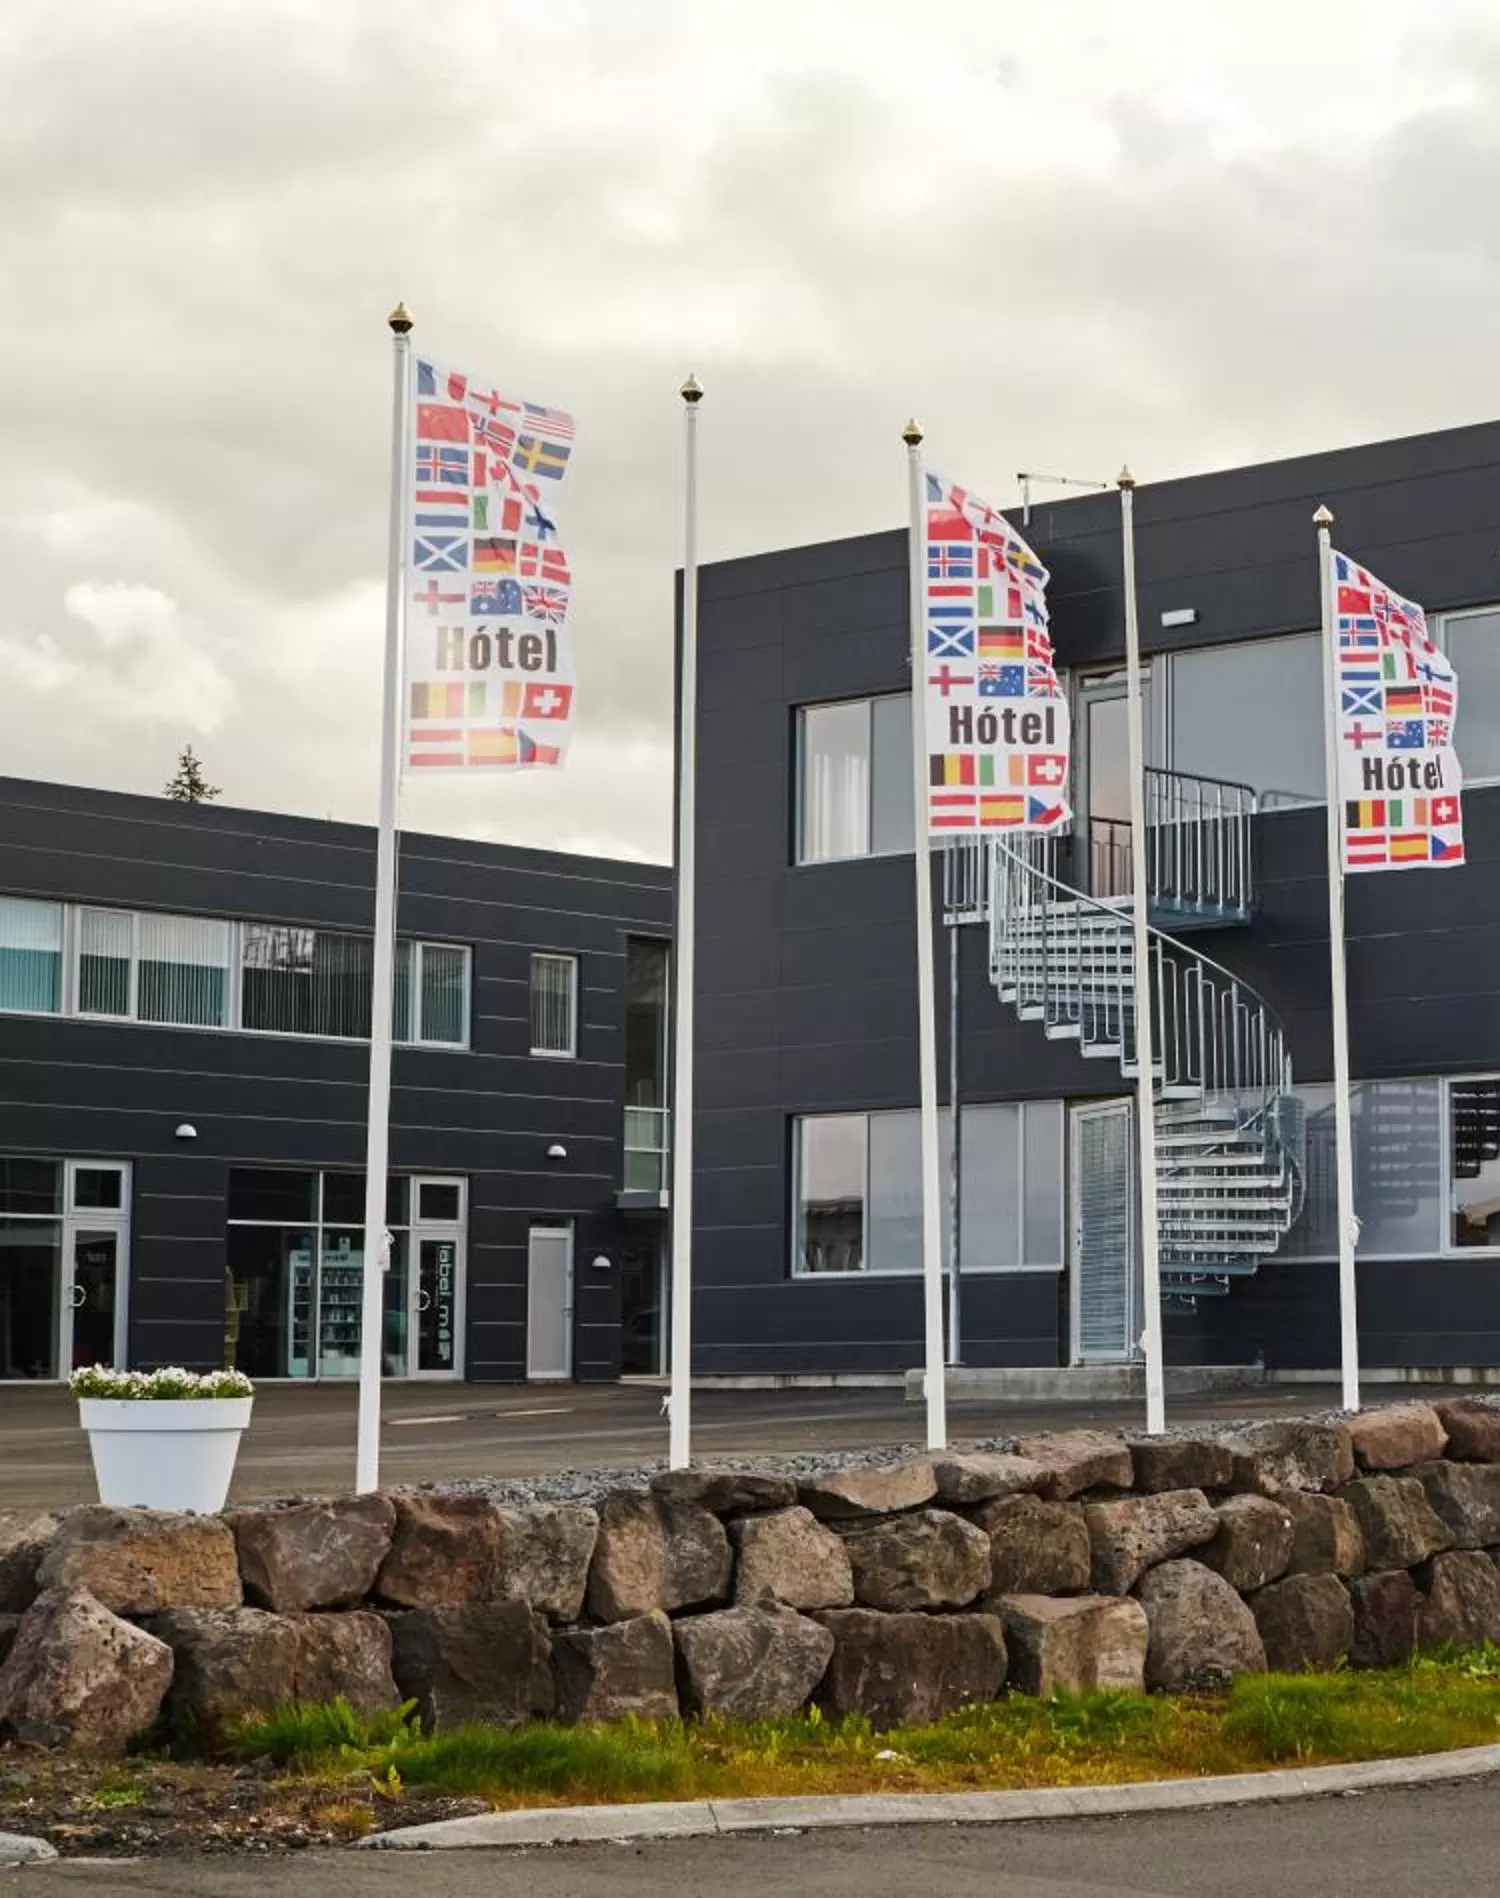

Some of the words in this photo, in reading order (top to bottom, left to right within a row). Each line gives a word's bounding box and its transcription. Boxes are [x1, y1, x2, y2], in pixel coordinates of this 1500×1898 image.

[436, 625, 557, 672] Hótel
[949, 705, 1055, 745] Hótel
[1362, 754, 1444, 791] Hótel
